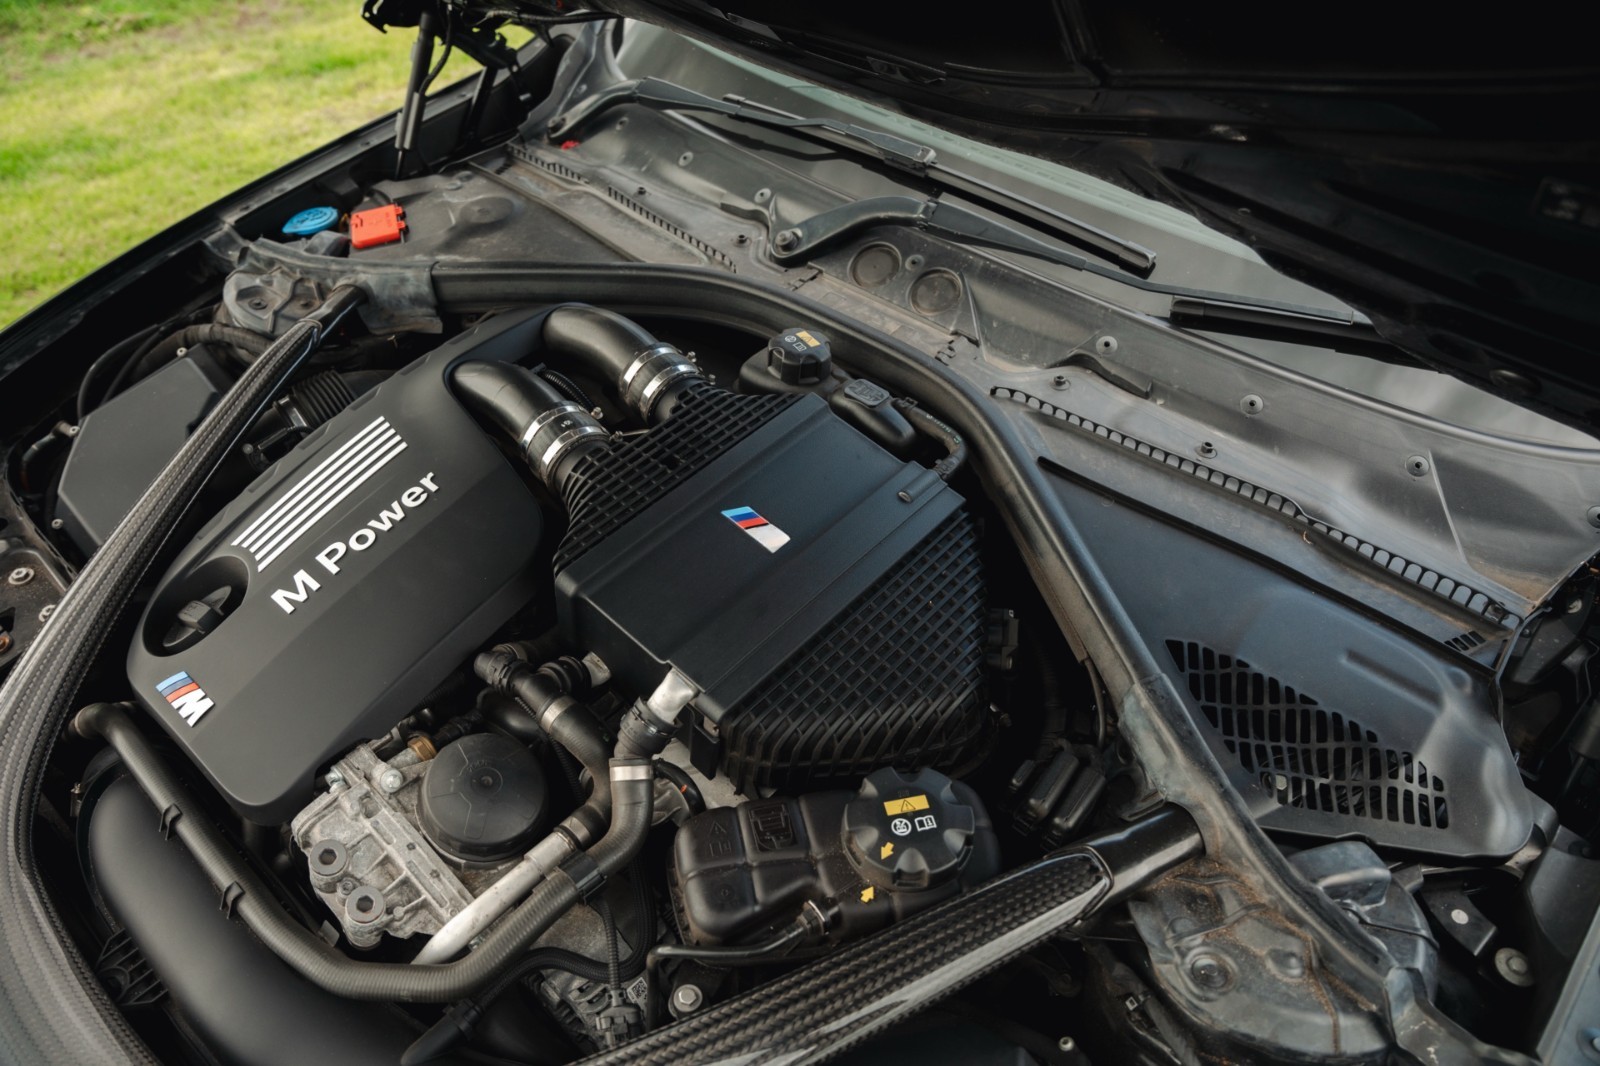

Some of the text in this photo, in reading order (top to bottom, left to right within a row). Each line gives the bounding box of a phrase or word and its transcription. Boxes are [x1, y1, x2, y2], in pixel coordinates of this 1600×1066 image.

[270, 472, 439, 615] M Power
[169, 688, 215, 727] M
